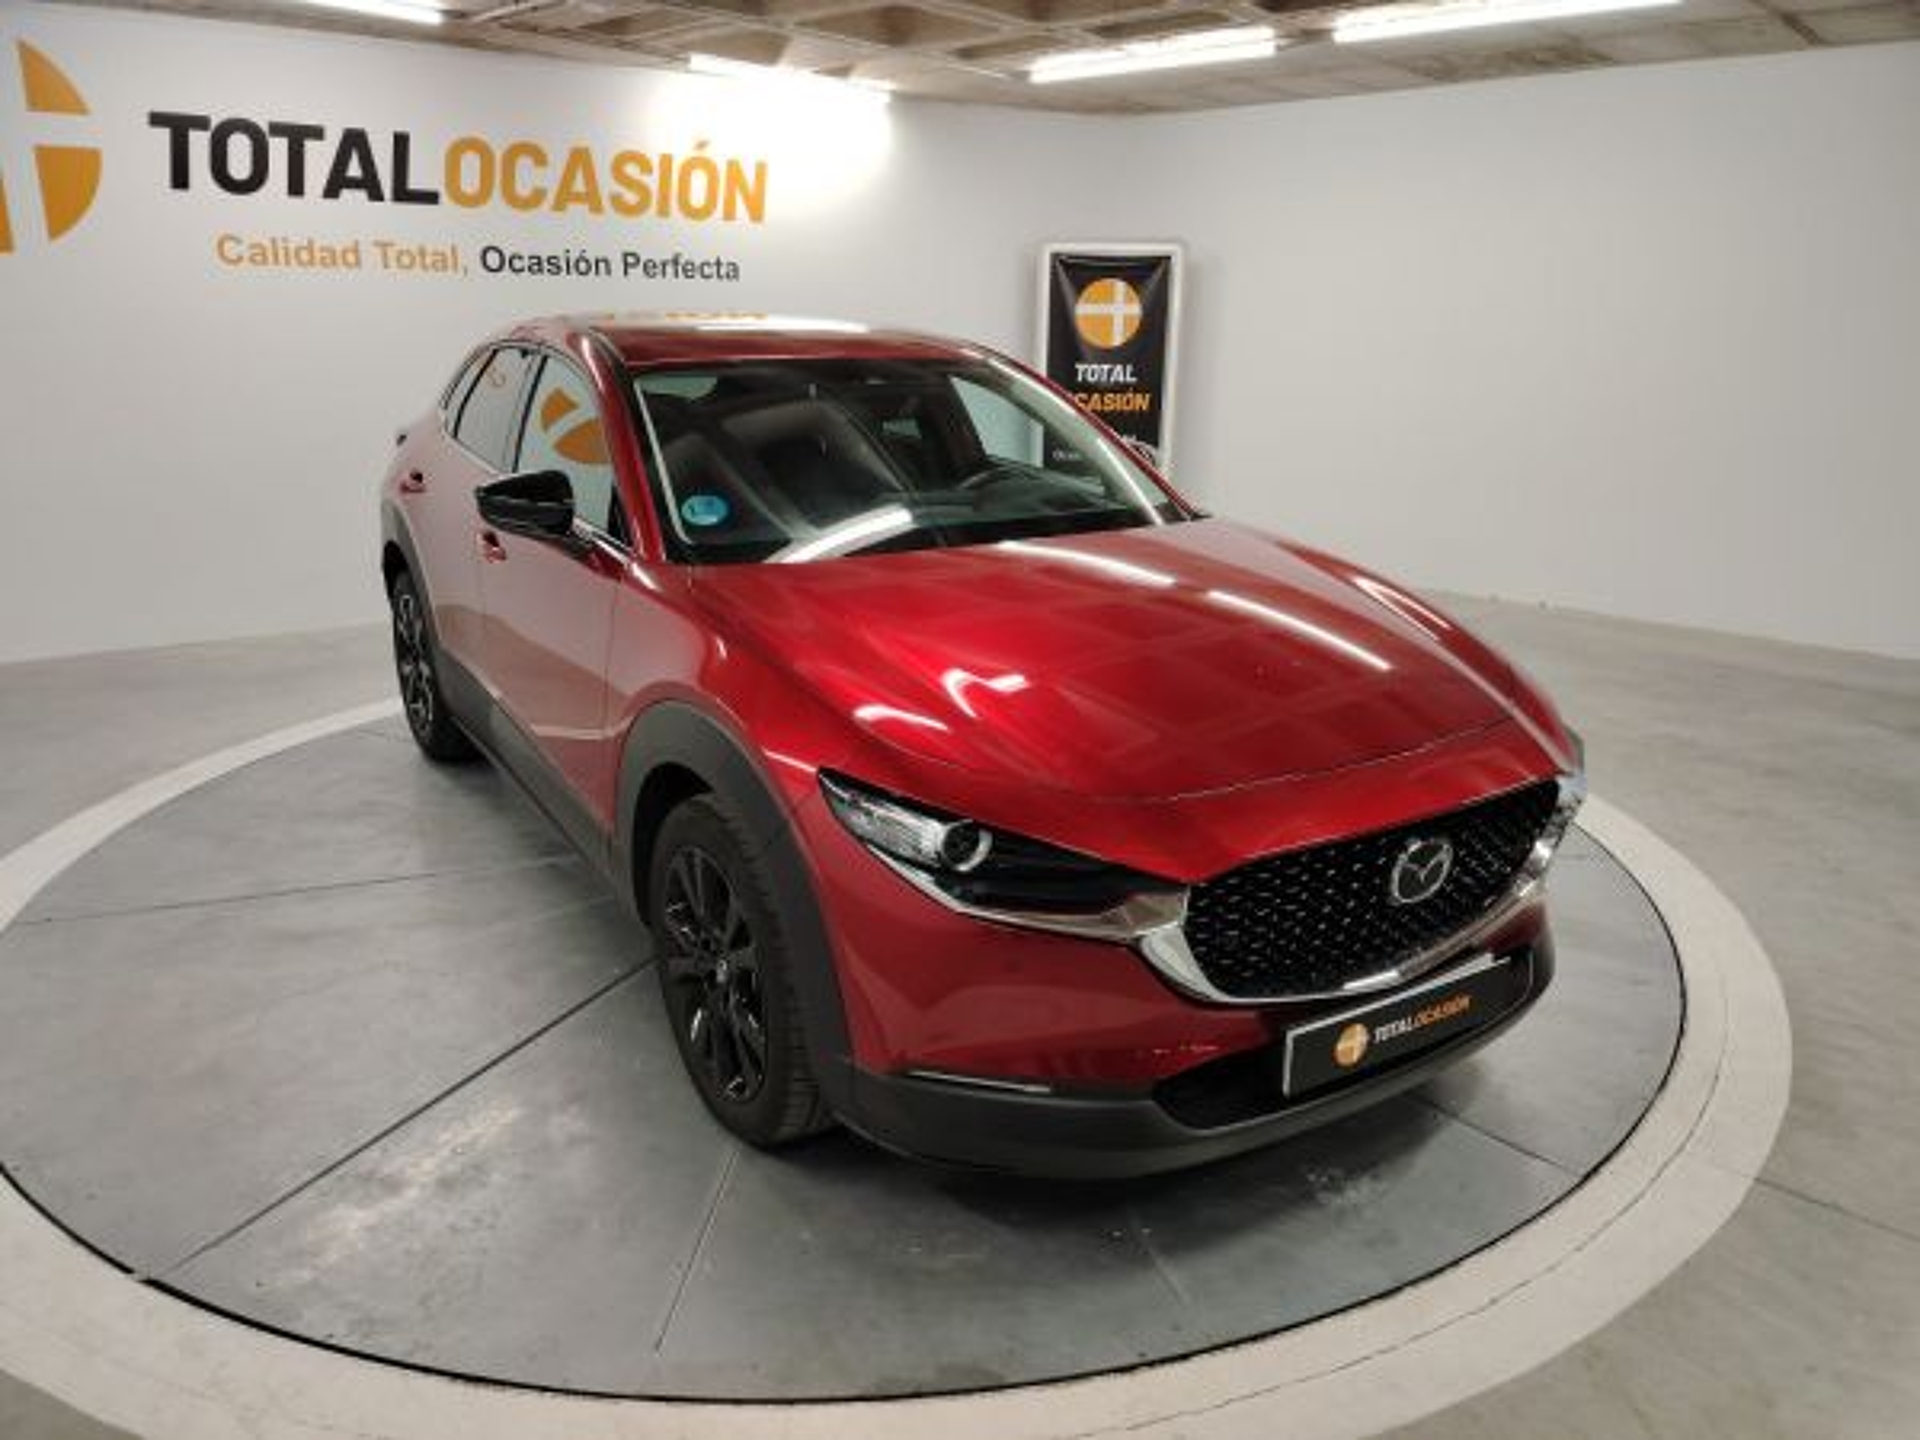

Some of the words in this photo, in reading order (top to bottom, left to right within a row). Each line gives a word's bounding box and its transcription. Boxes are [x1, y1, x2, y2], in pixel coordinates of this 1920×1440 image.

[215, 233, 362, 269] Calidad
[373, 240, 468, 276] Total,
[480, 246, 612, 276] Ocasión
[621, 252, 740, 281] Perfecta
[1074, 363, 1137, 383] TOTAL
[1071, 388, 1151, 411] CASIÓN
